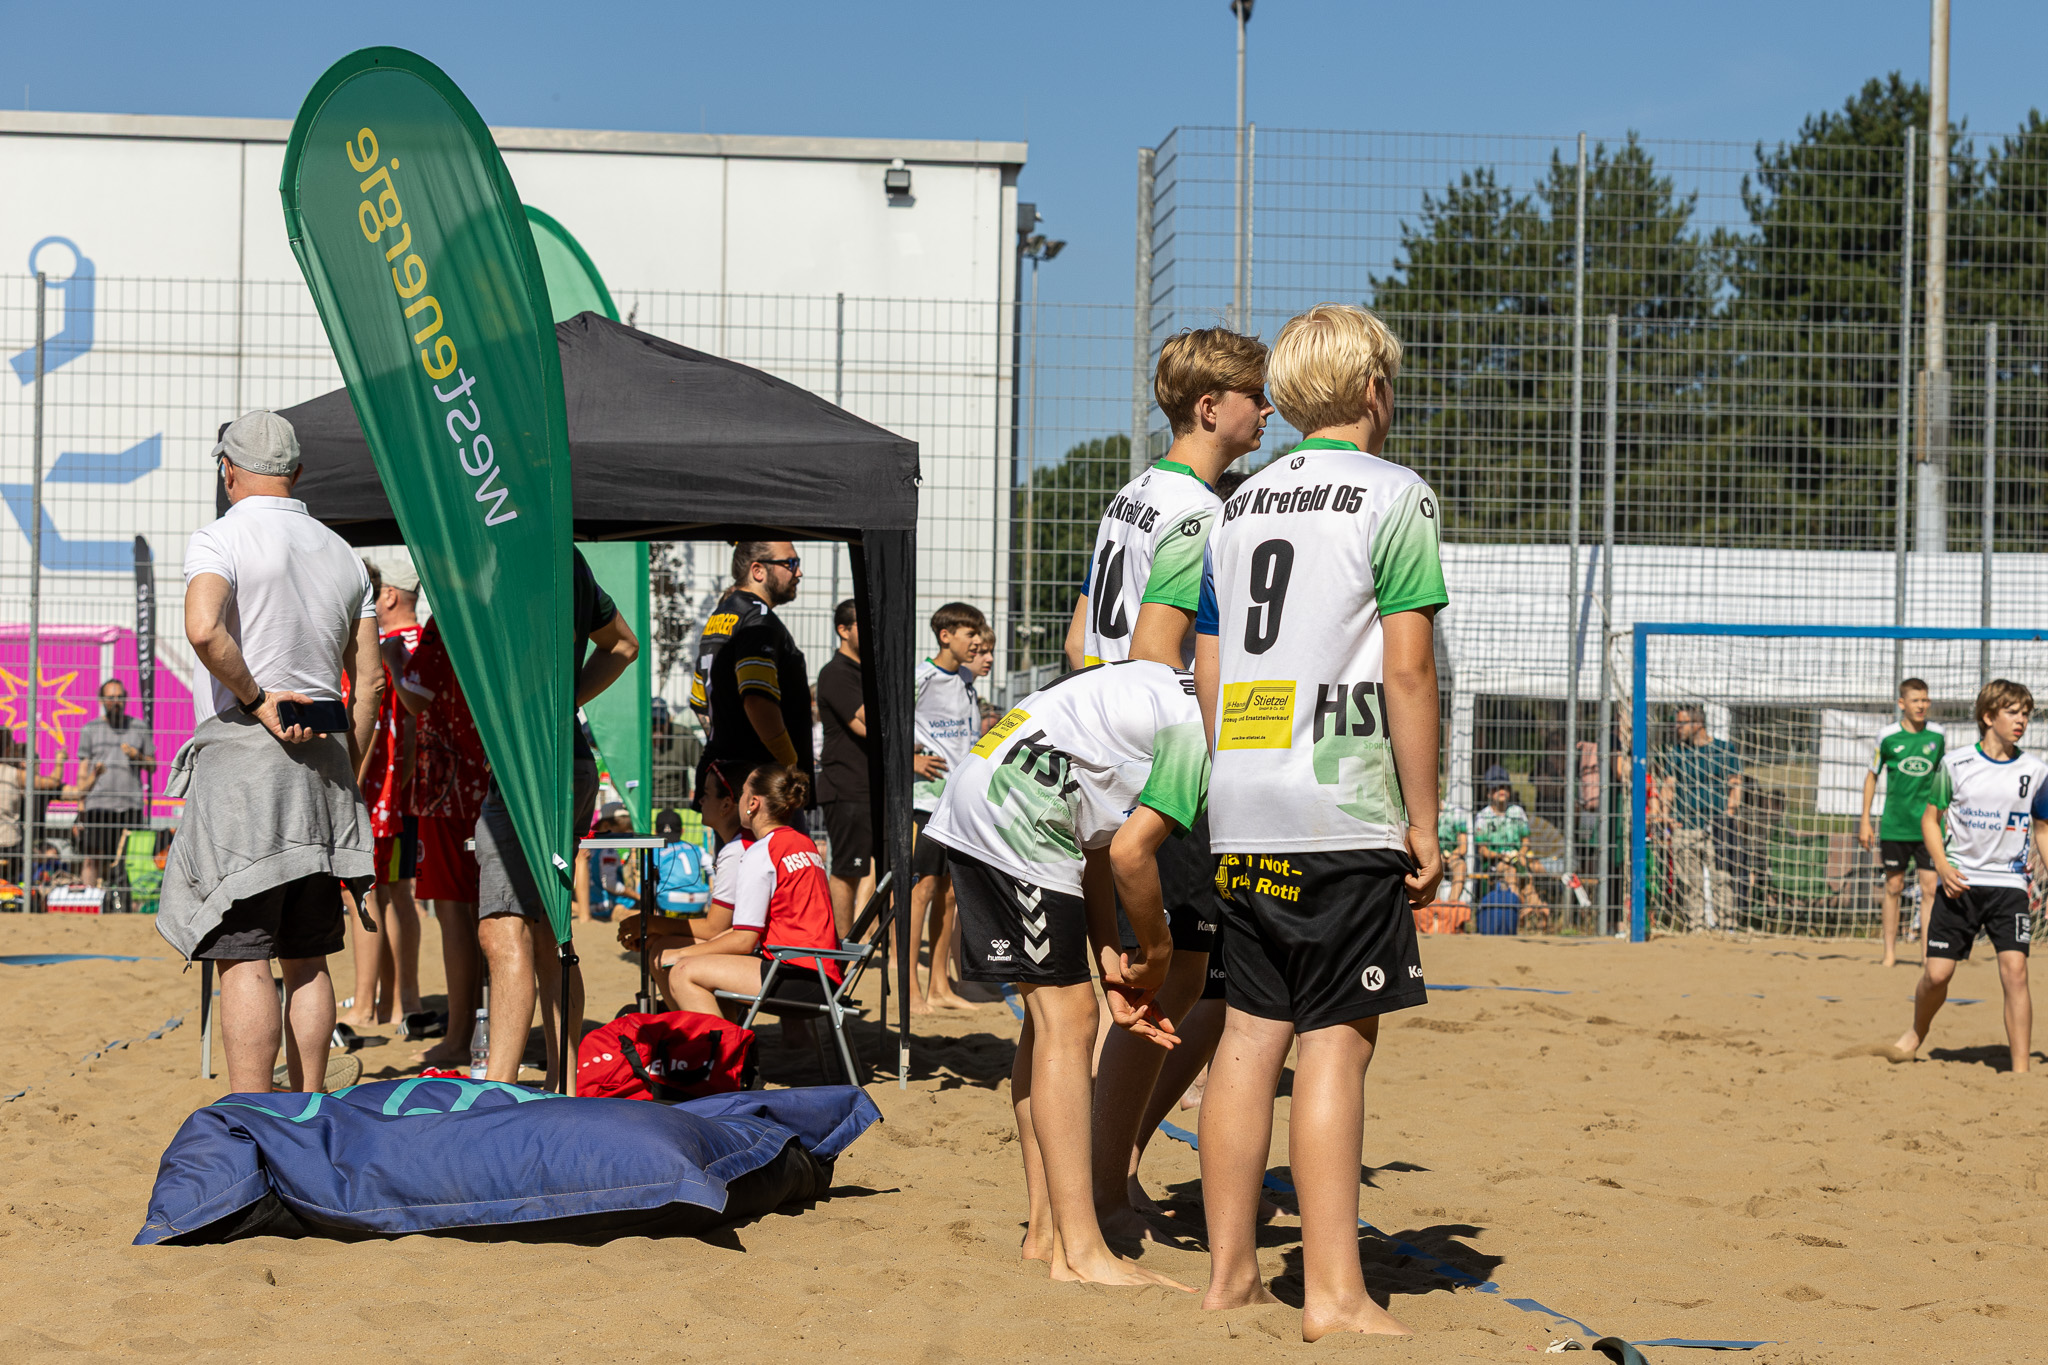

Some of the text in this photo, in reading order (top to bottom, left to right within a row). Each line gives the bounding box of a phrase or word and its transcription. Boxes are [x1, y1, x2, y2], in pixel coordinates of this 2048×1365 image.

[1222, 484, 1367, 527] HSV Krefeld 05
[1244, 538, 1295, 655] 9
[1253, 694, 1289, 706] Stietzel
[2018, 774, 2031, 798] 8
[781, 851, 812, 874] HSG
[987, 953, 1012, 962] hummel
[1210, 969, 1227, 979] Ke
